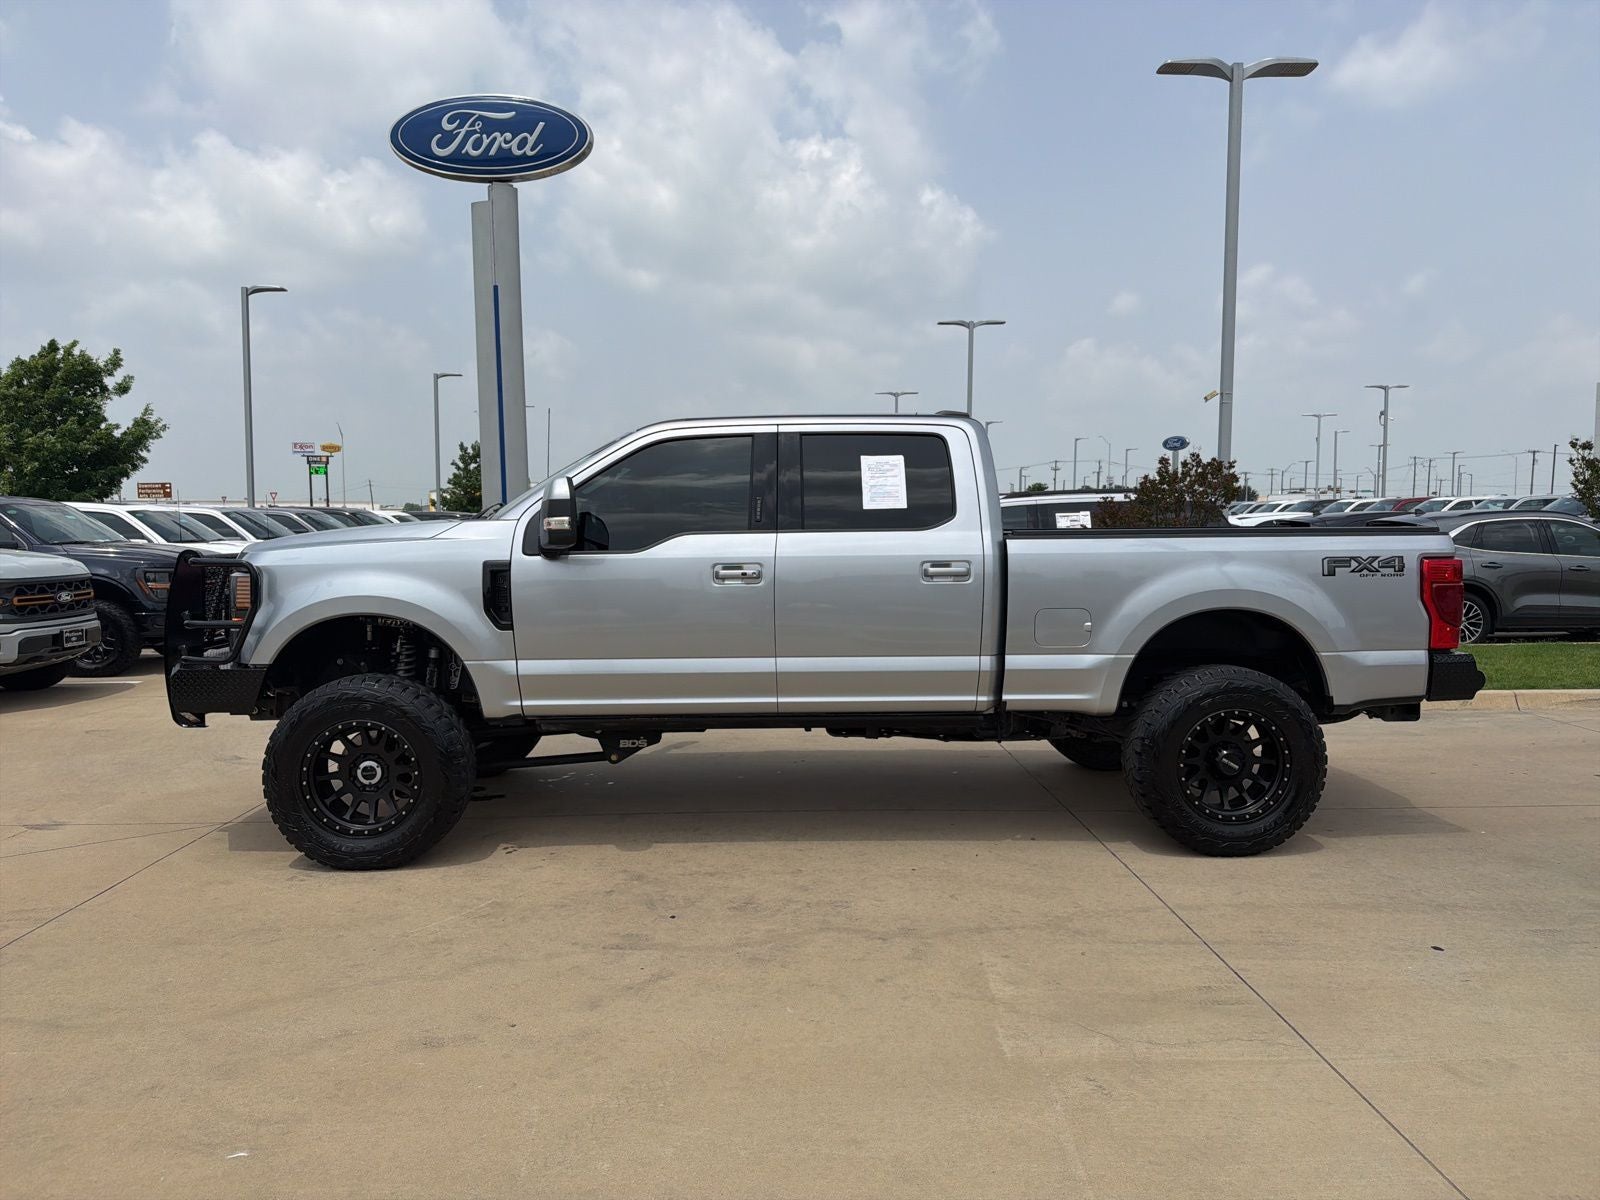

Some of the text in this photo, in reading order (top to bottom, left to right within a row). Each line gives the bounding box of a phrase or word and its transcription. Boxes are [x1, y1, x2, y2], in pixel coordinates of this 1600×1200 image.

[431, 109, 545, 157] Ford
[293, 443, 314, 451] Exxon
[1322, 556, 1405, 577] FX4
[619, 739, 648, 748] BDS
